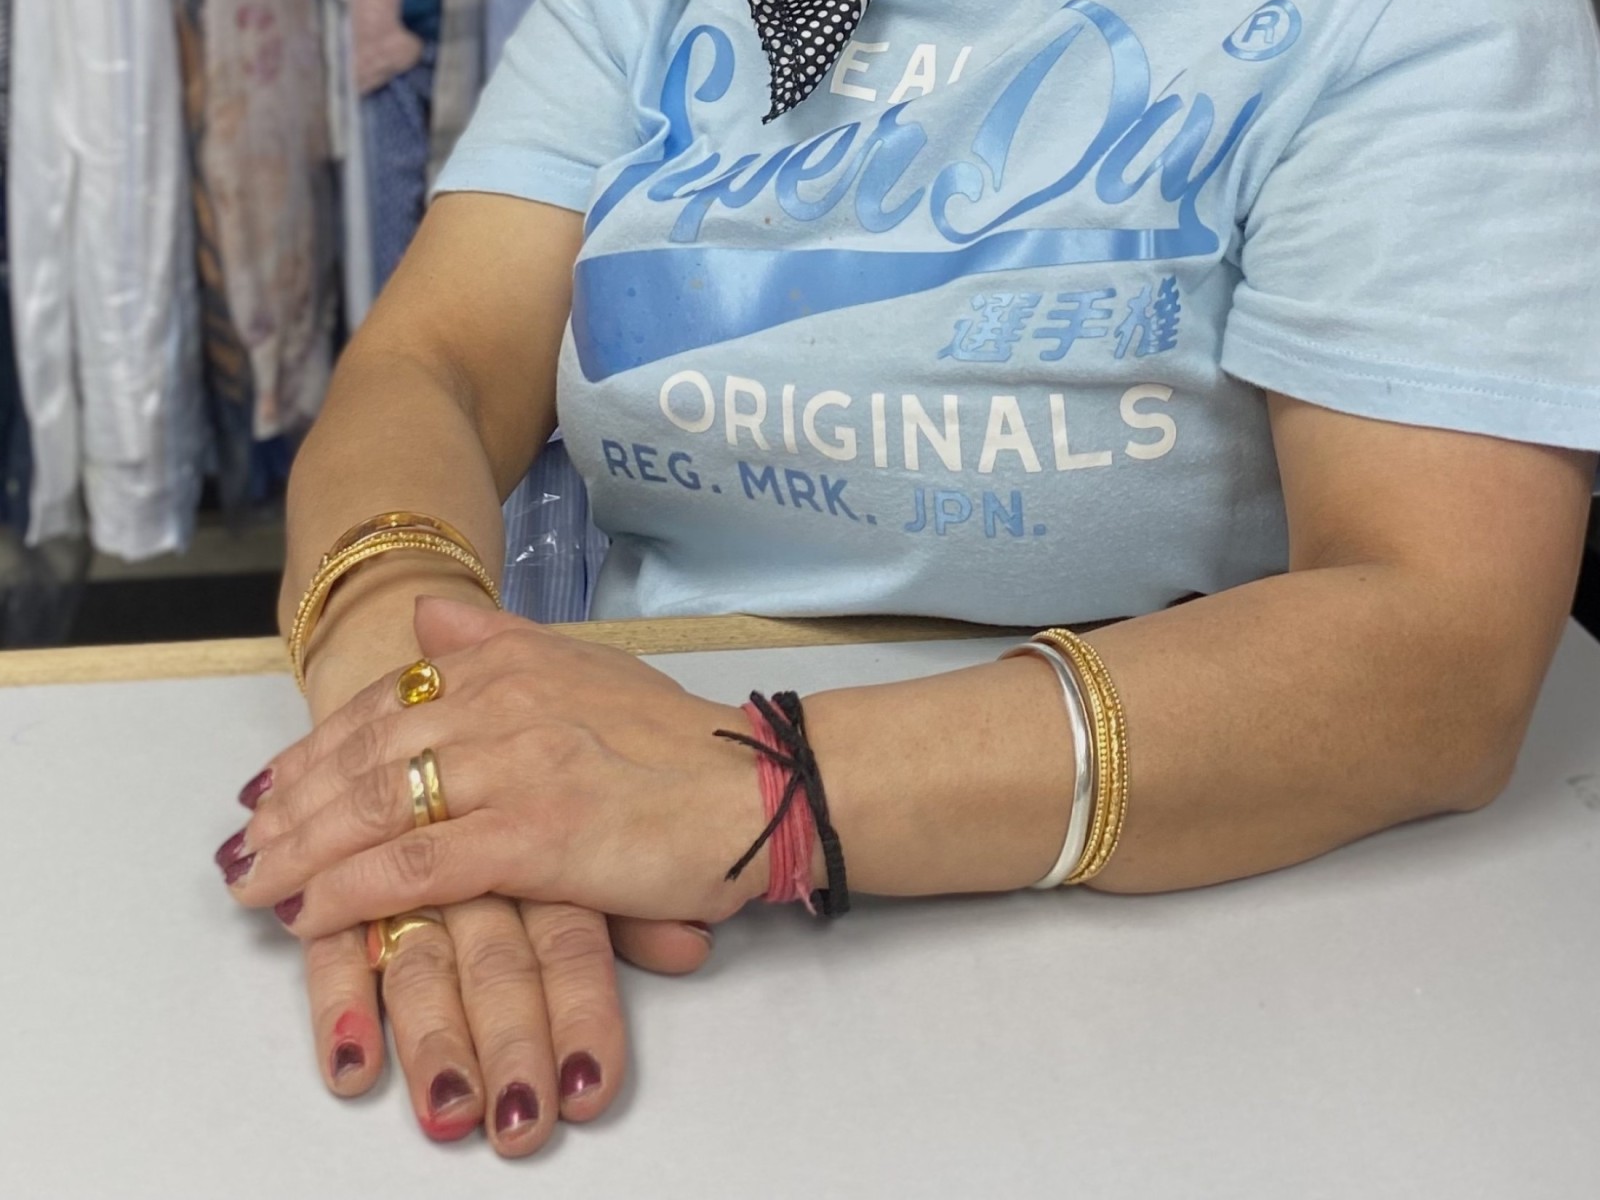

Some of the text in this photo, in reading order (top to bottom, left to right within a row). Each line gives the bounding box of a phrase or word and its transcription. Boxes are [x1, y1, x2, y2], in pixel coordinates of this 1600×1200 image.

[830, 39, 973, 104] EA
[659, 370, 1178, 474] ORIGINALS
[601, 439, 1048, 538] REG. MRK. JPN.
